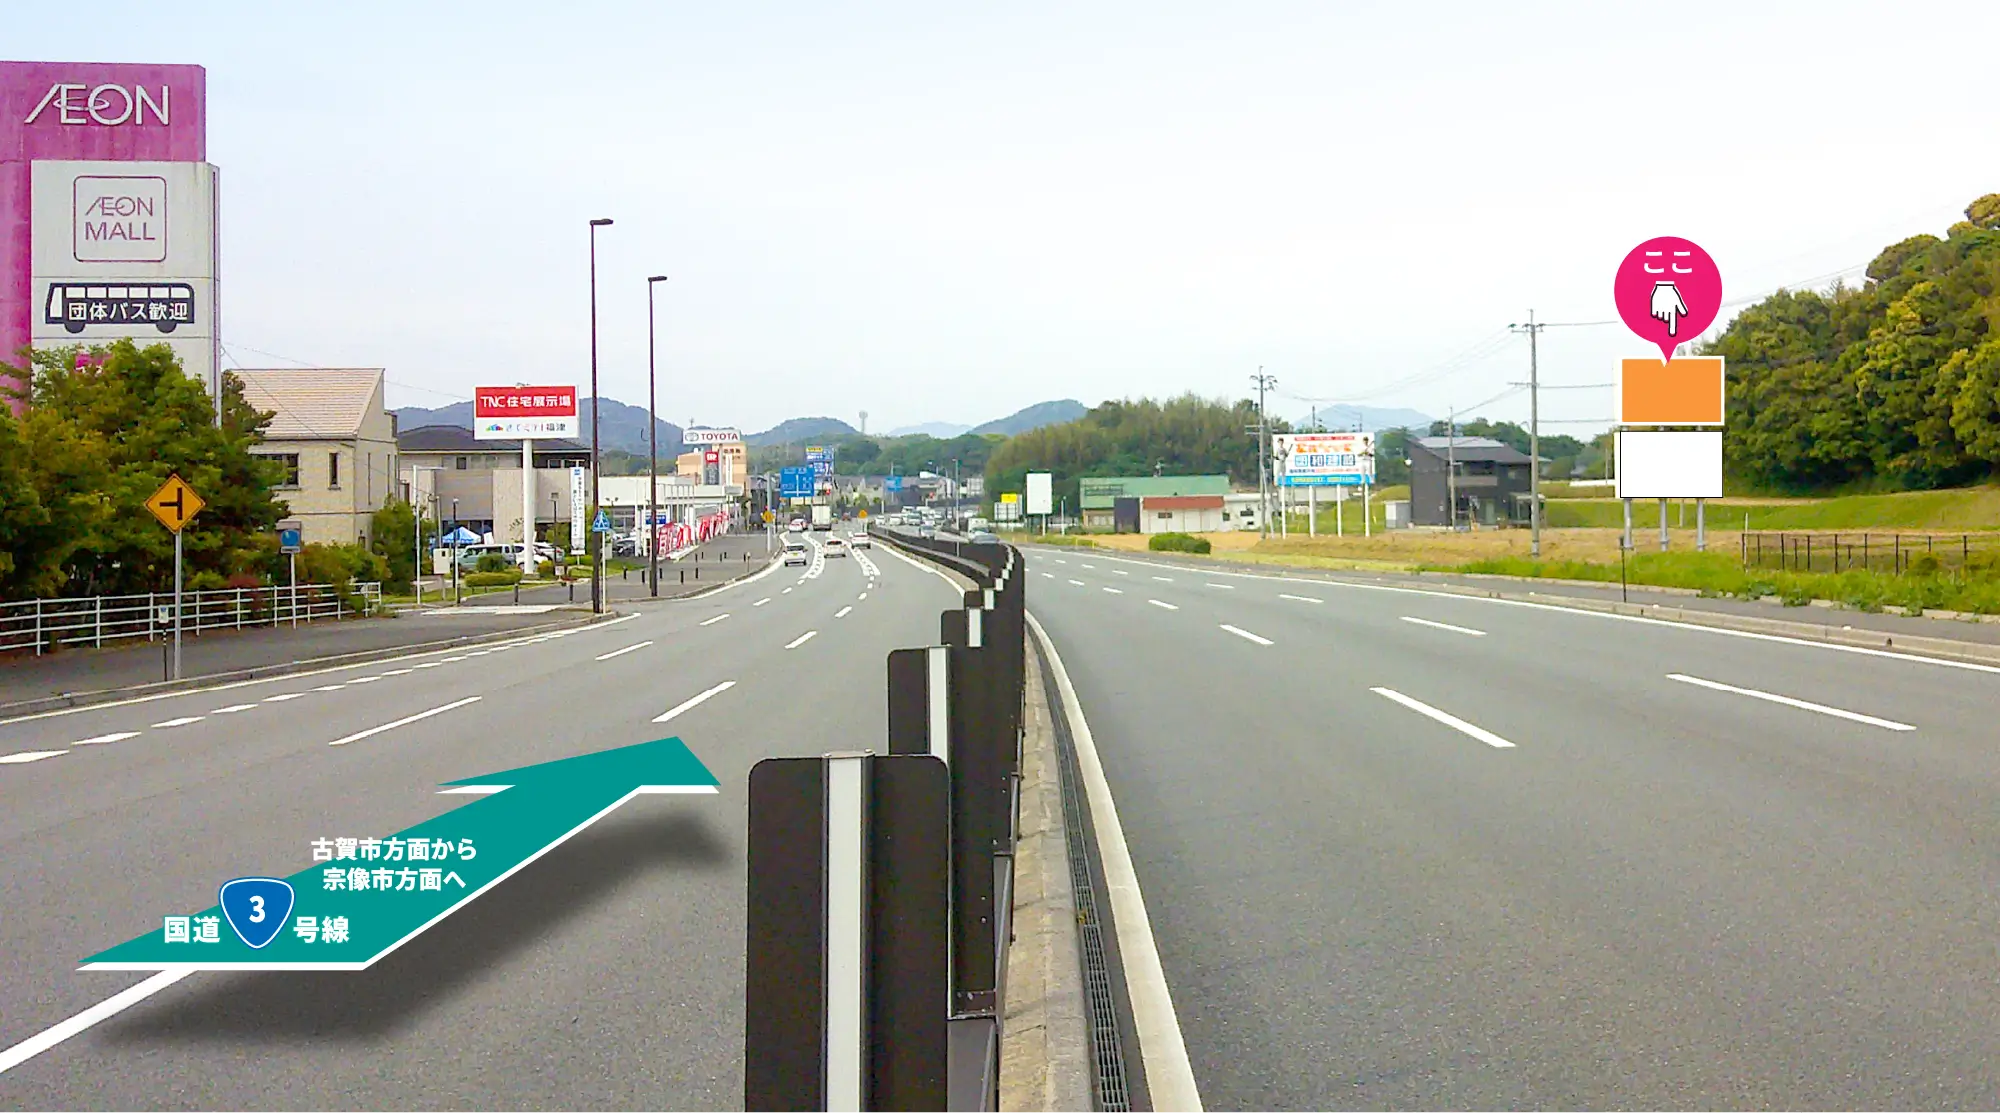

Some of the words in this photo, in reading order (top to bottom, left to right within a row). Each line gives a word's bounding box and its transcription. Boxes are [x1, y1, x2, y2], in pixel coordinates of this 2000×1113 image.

[85, 222, 155, 241] MALL
[68, 302, 189, 321] 団体バス歓迎
[701, 432, 738, 441] TOYOTA
